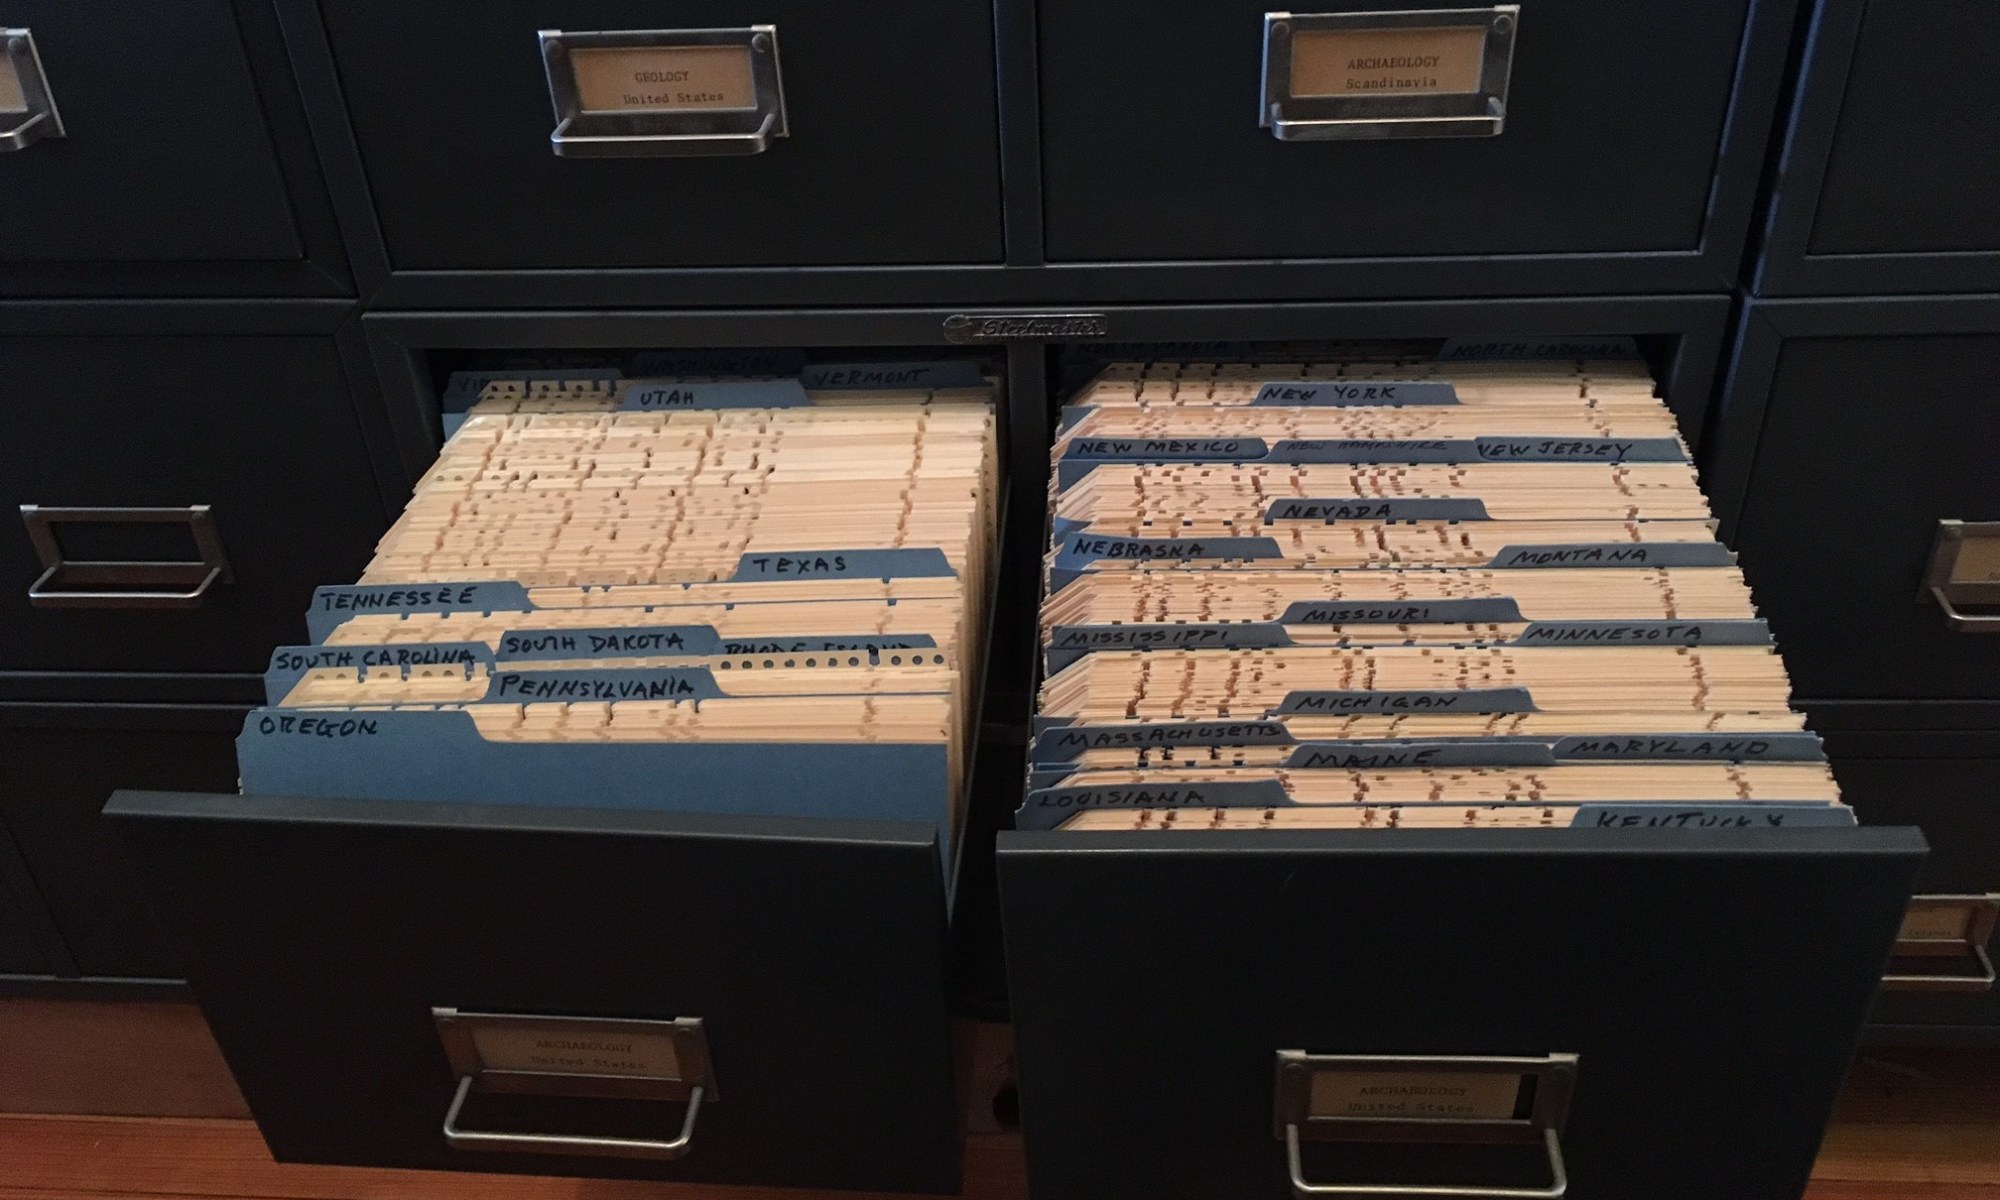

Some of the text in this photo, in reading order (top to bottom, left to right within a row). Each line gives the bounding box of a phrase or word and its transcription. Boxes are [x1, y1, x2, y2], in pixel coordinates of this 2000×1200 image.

[1347, 56, 1440, 70] ARCHAEOLOGY
[635, 71, 689, 83] GEOLOGY
[1346, 78, 1437, 89] Scandinavia
[623, 92, 724, 105] United States
[814, 369, 930, 385] VERMONT
[639, 390, 694, 405] UTAH
[1263, 386, 1397, 400] NEW YORK
[1078, 441, 1240, 454] NEW MEXICO
[1538, 440, 1633, 461] JERSEY
[1282, 503, 1392, 519] NEVADA
[1072, 537, 1206, 558] NEBRASKA
[1509, 548, 1648, 564] MONTANA
[752, 556, 846, 574] TEXAS
[319, 586, 478, 610] TENNESSEE
[1301, 608, 1431, 622] MISSOURI
[1060, 631, 1227, 646] MISSISSIPPI
[1527, 626, 1702, 640] MINNESOTA
[506, 632, 685, 653] SOUTH DAKOTA
[276, 648, 476, 671] SOUTH CAROLINA
[500, 675, 695, 697] PENNSYLVANIA
[1295, 697, 1458, 710] MICHIGAN
[259, 716, 377, 737] OREGON
[1057, 724, 1281, 747] MASSACHUSETTS
[1570, 740, 1770, 755] MARYLAND
[1303, 749, 1441, 767] MAINE
[1038, 789, 1206, 807] LOUISIANA
